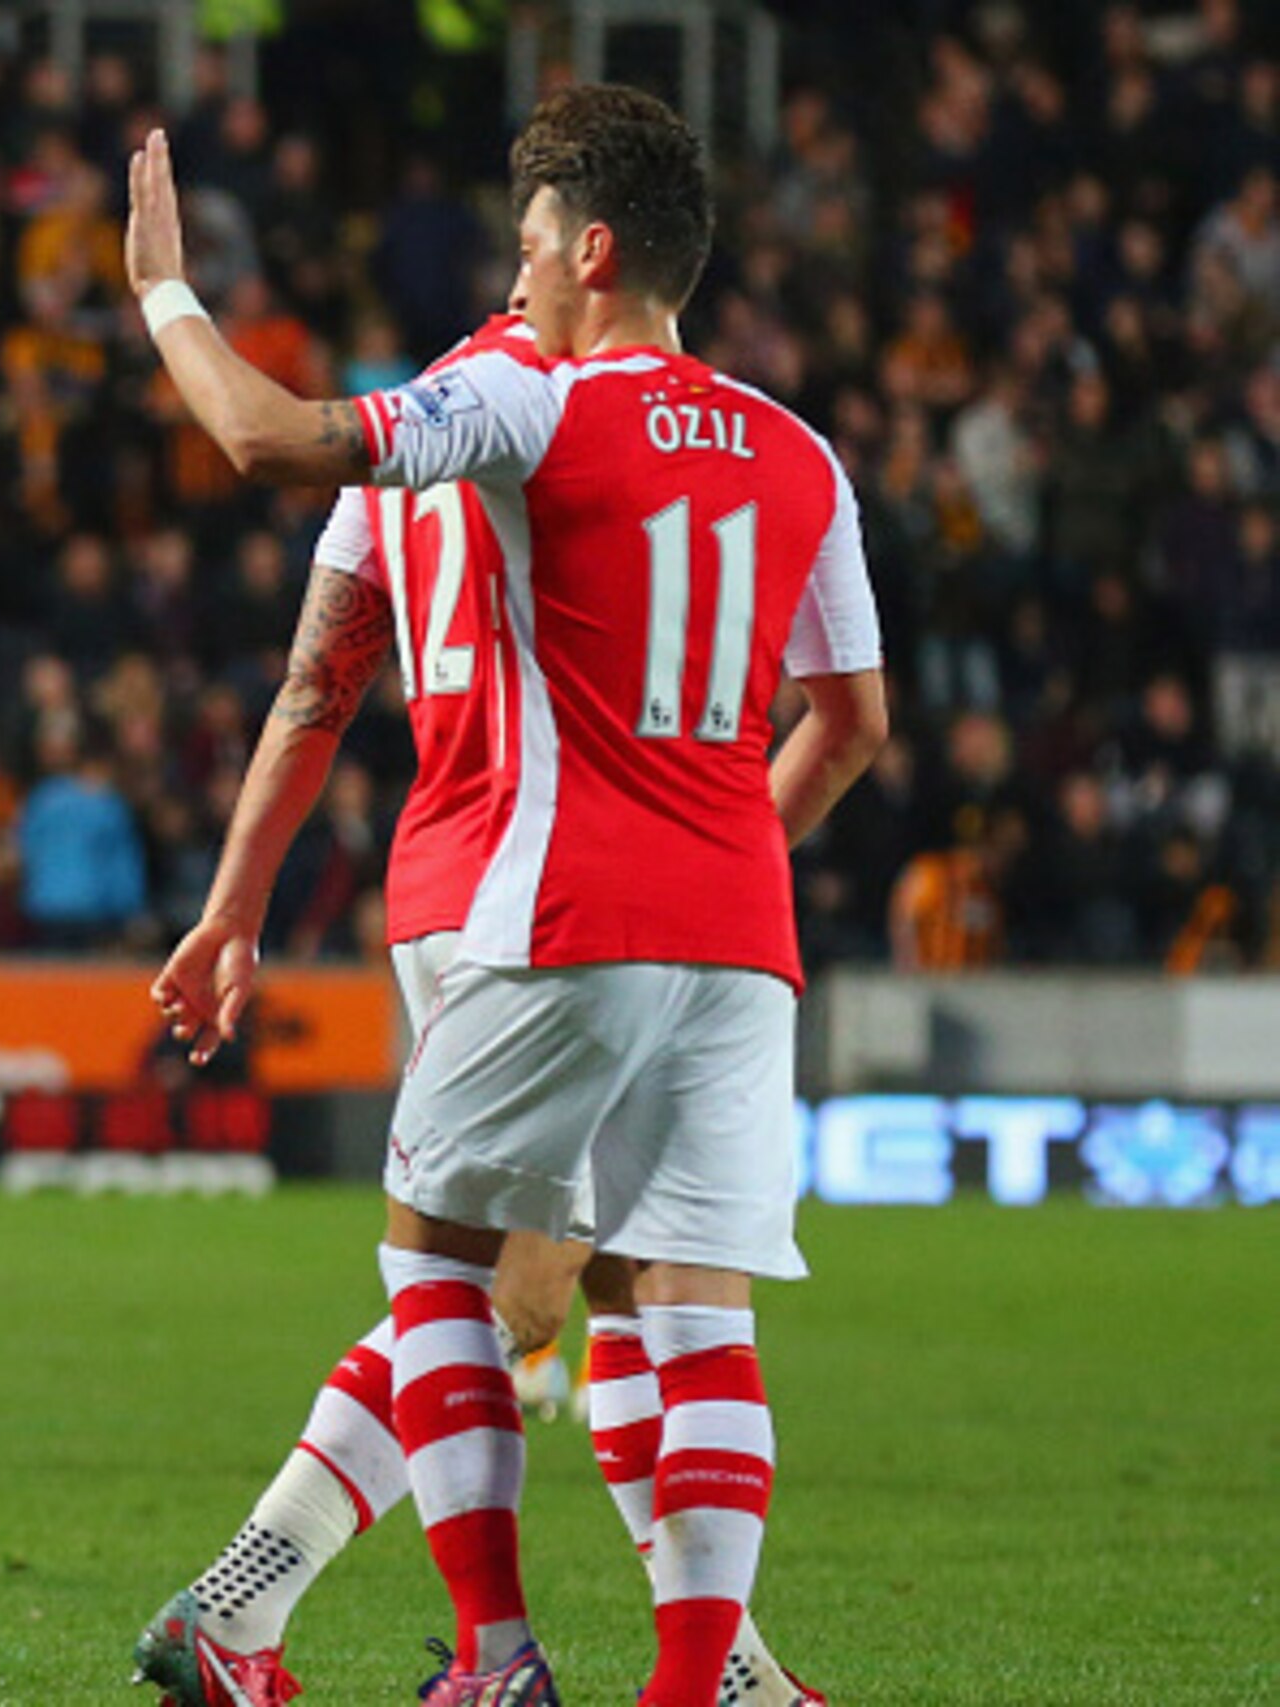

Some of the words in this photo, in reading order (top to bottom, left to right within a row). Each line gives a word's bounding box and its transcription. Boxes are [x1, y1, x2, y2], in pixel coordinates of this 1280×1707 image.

[641, 390, 755, 459] ÖZIL
[378, 482, 475, 700] 12
[634, 496, 757, 742] 11
